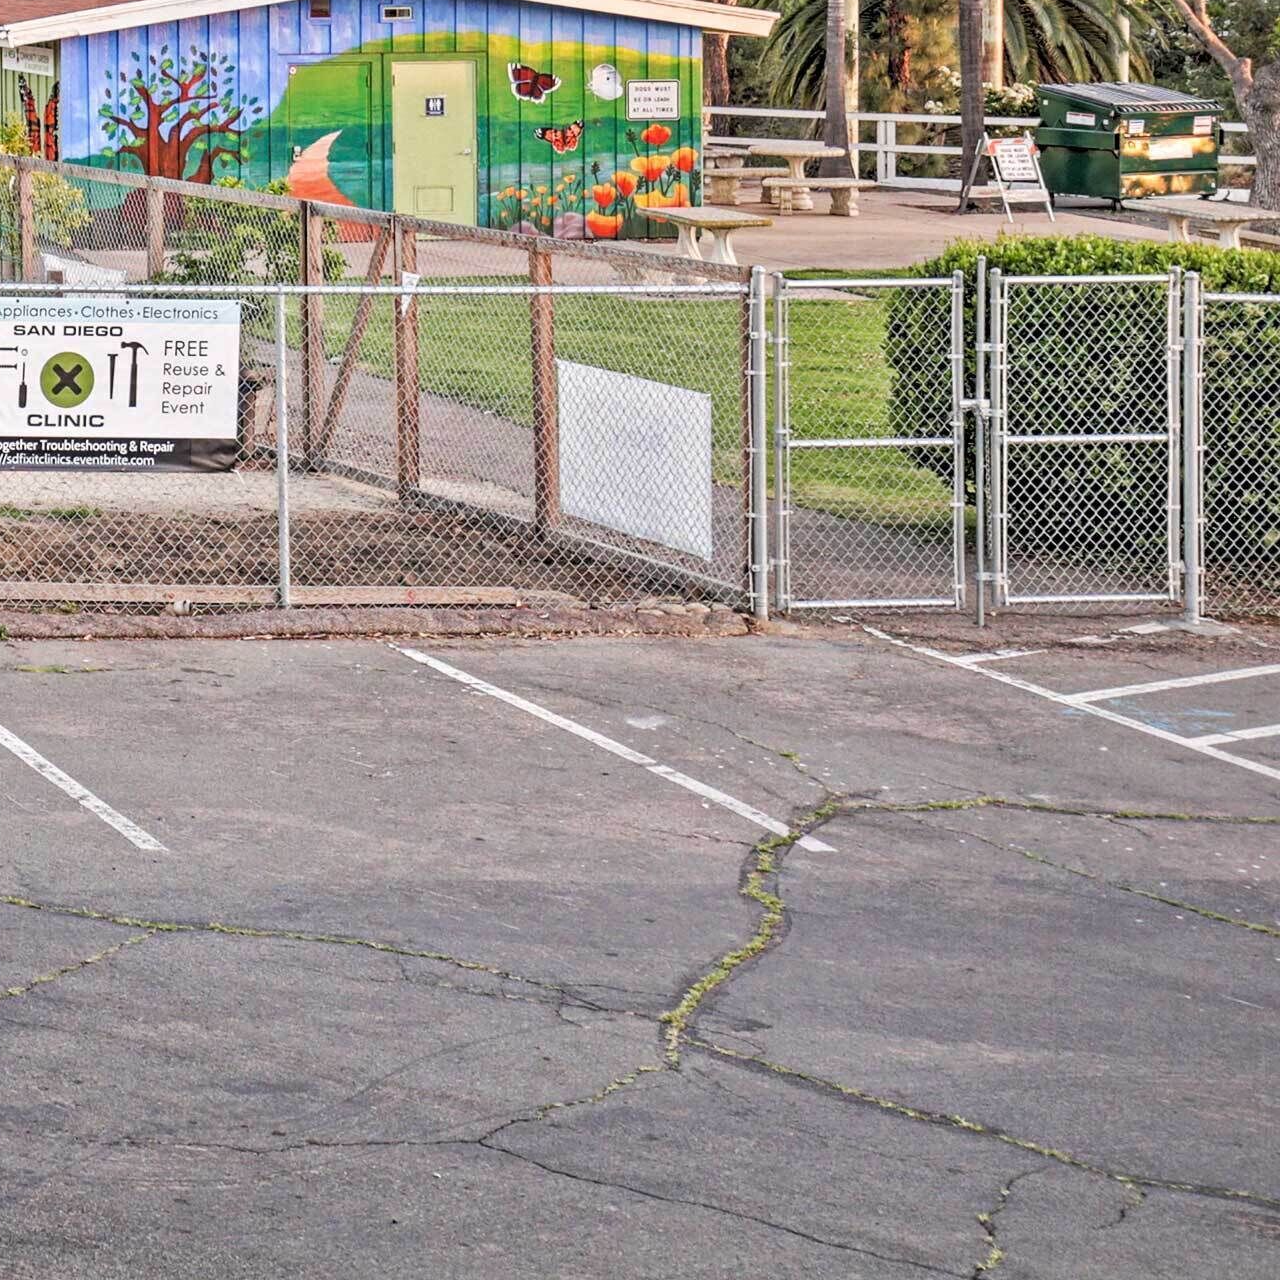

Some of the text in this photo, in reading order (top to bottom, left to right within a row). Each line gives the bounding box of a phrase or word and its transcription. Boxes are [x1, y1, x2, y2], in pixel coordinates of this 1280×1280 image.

[81, 305, 134, 318] Clothes
[142, 306, 219, 320] Electronics
[13, 325, 122, 336] SAN DIEGO
[165, 341, 208, 356] FREE
[164, 363, 225, 376] Reuse &
[163, 382, 212, 397] Repair
[162, 401, 204, 414] Event
[27, 414, 104, 427] CLINIC
[40, 439, 127, 455] Troubleshooting
[129, 441, 137, 452] &
[140, 441, 174, 455] Repair
